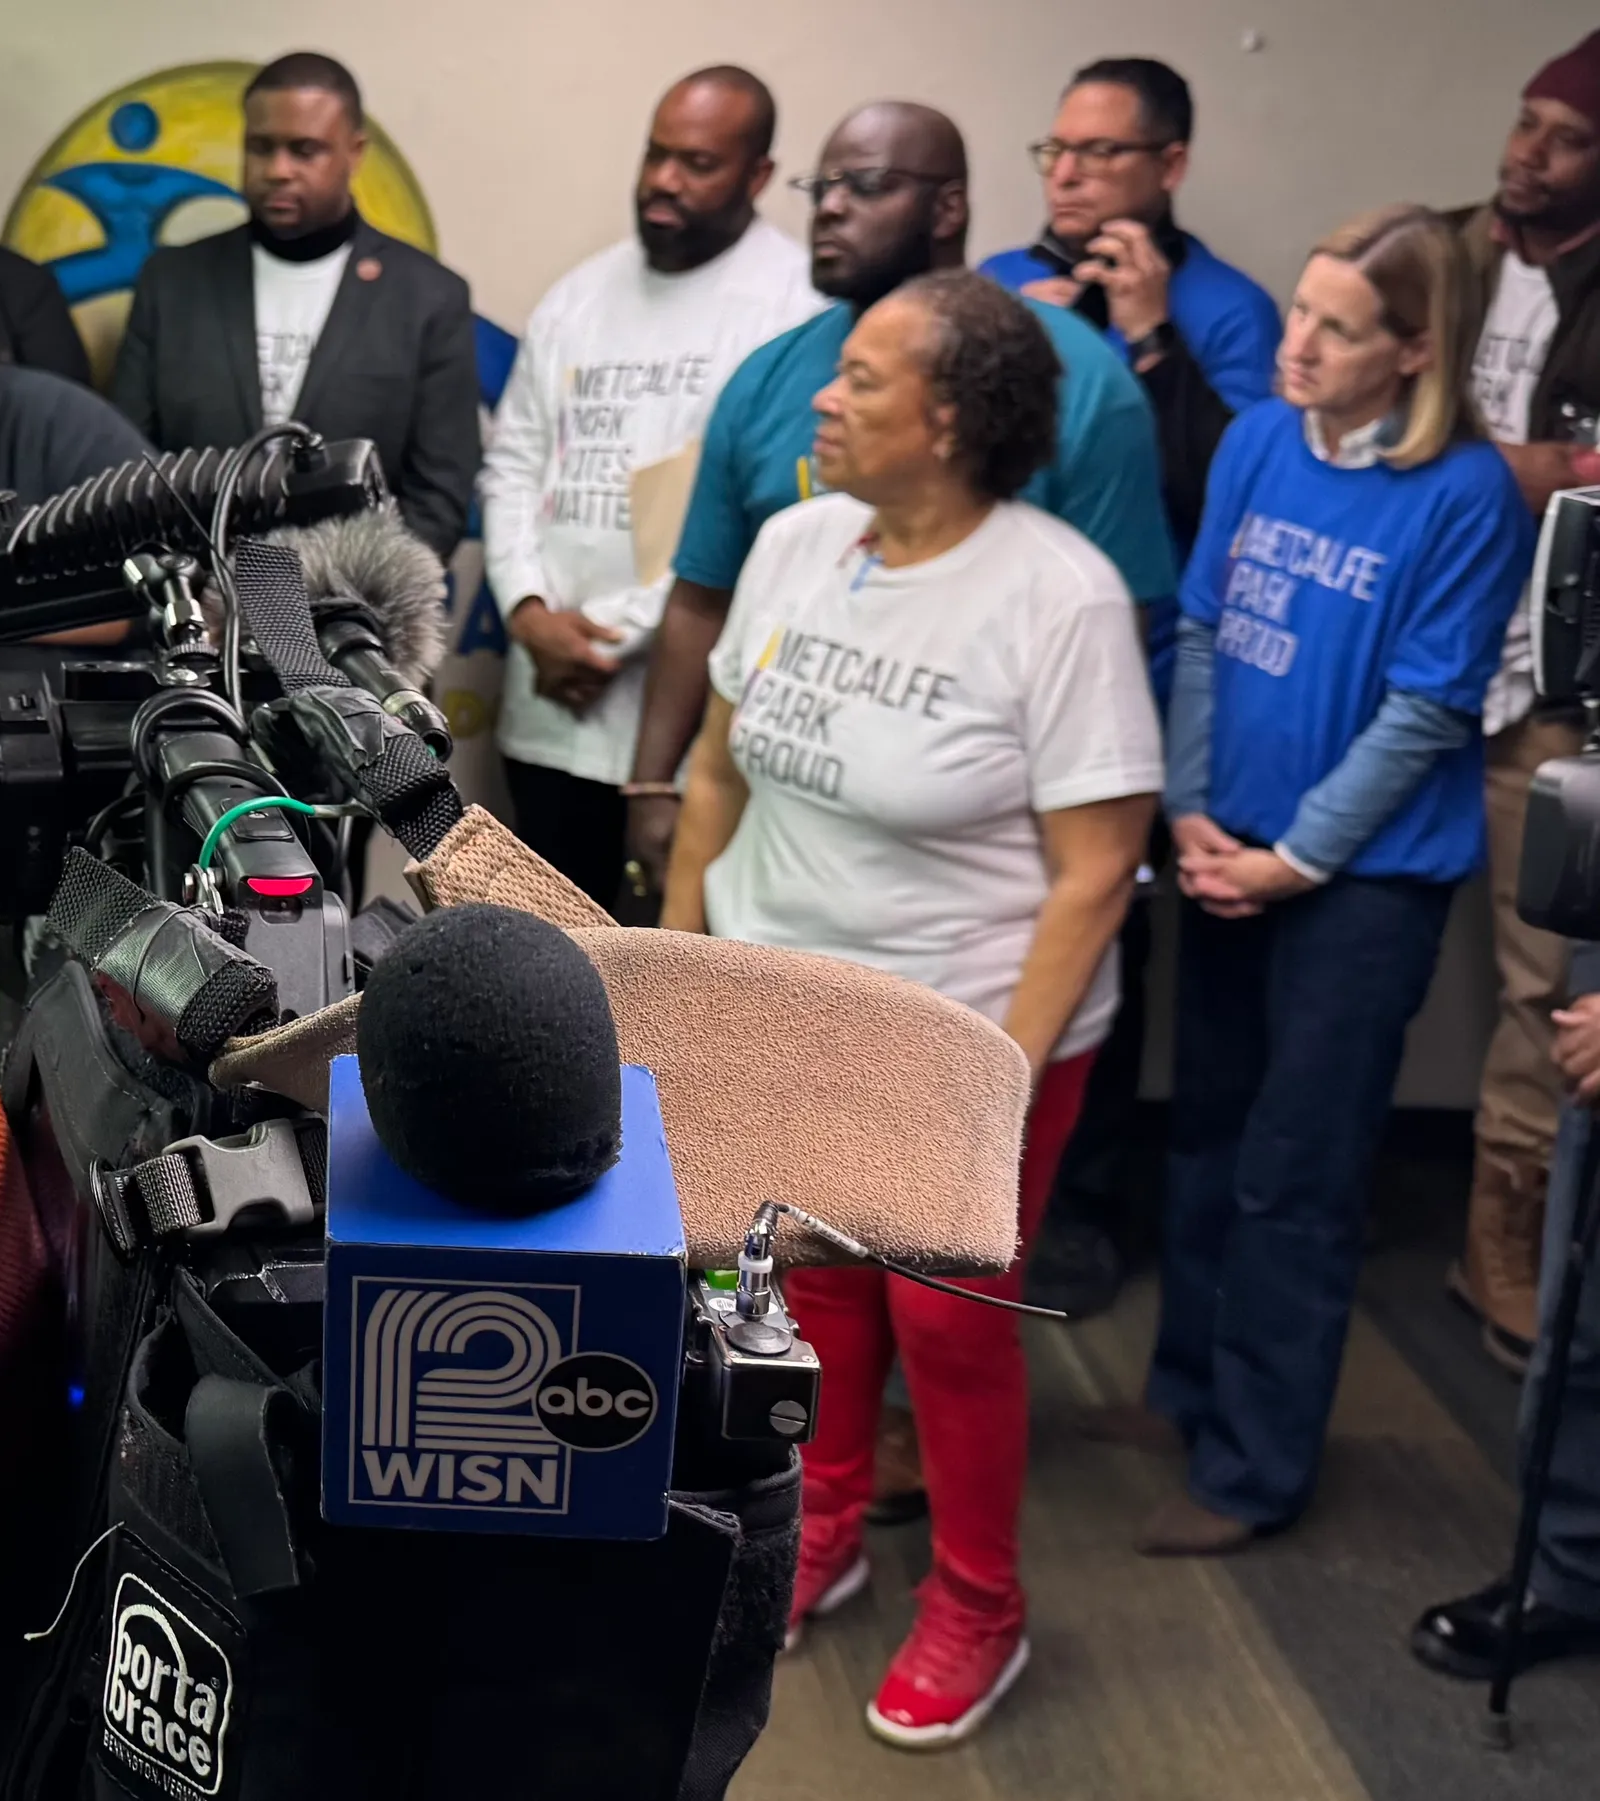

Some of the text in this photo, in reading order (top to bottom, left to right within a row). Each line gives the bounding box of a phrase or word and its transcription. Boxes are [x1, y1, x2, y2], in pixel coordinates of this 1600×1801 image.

[1238, 513, 1390, 602] METCALFE
[752, 676, 844, 747] PARK
[776, 625, 960, 722] METCALFE
[731, 724, 845, 801] PROUD
[537, 1376, 650, 1418] abc
[361, 1450, 559, 1505] WISN
[111, 1604, 217, 1736] porta
[109, 1678, 212, 1777] brace
